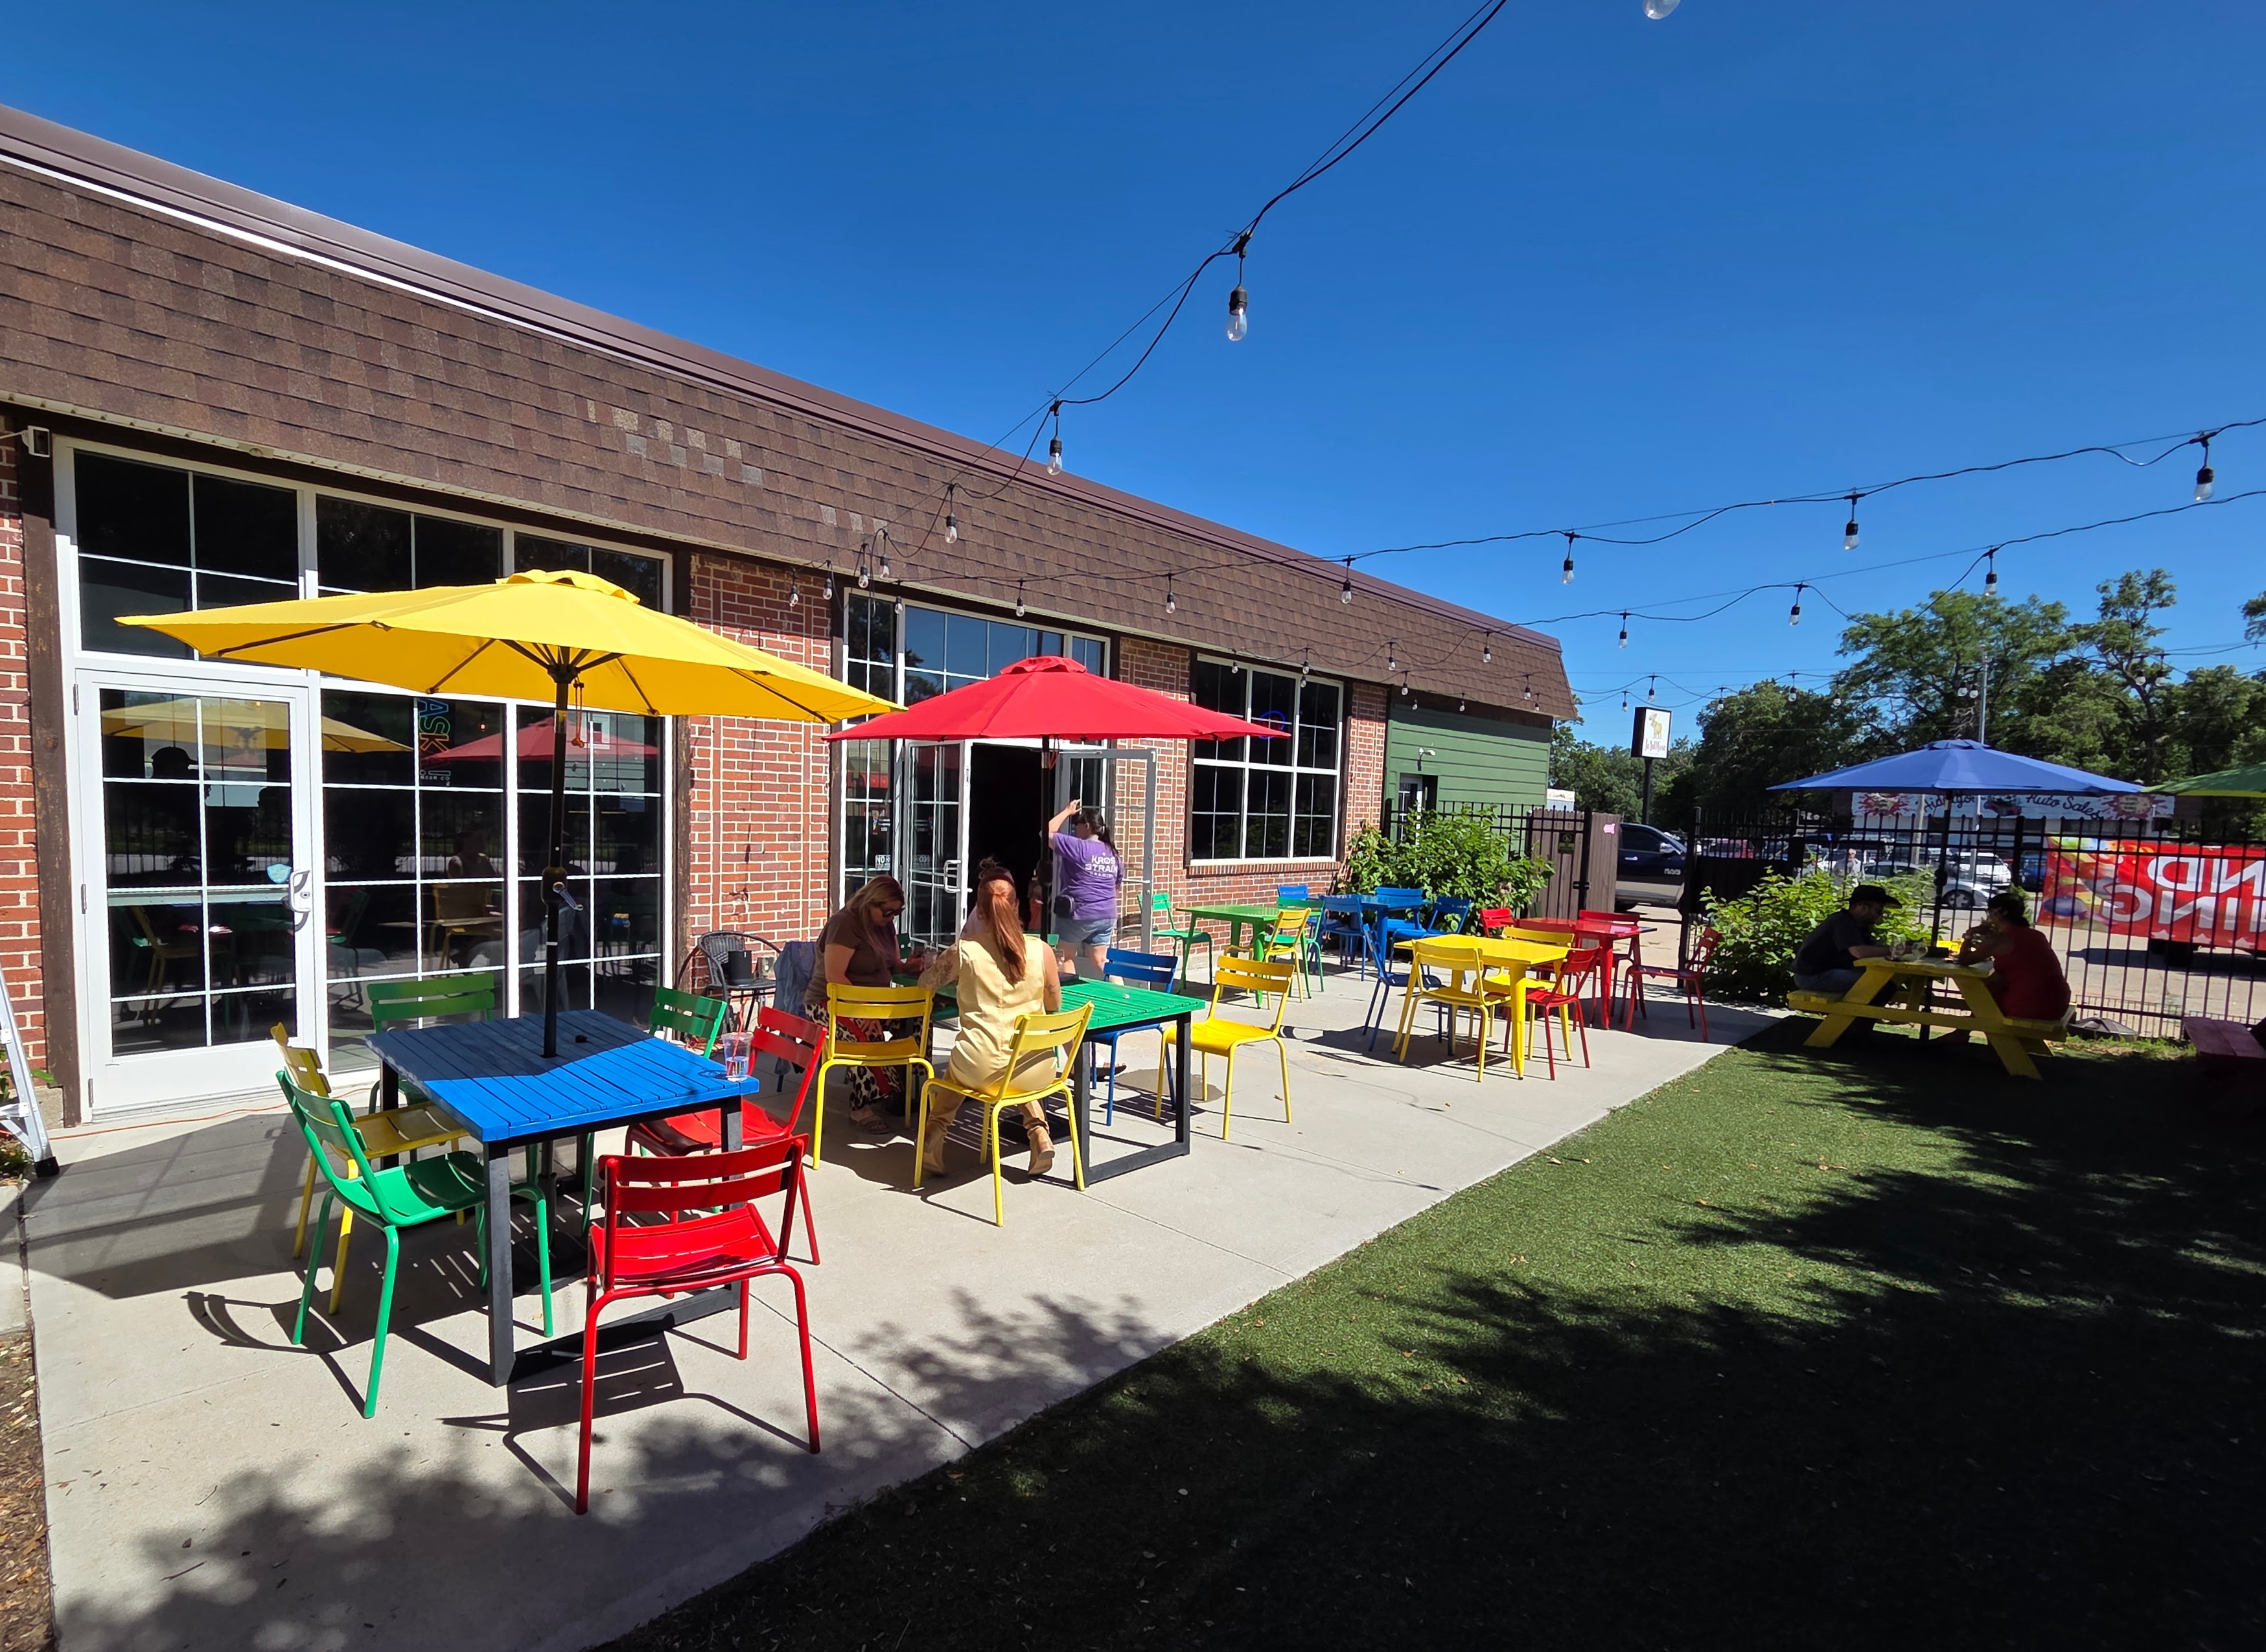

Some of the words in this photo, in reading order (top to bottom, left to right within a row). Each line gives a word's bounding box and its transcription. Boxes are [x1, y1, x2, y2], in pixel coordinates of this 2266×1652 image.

[2063, 796, 2104, 820] Sales
[1092, 855, 1115, 865] KROS
[1085, 863, 1118, 873] STRAIN
